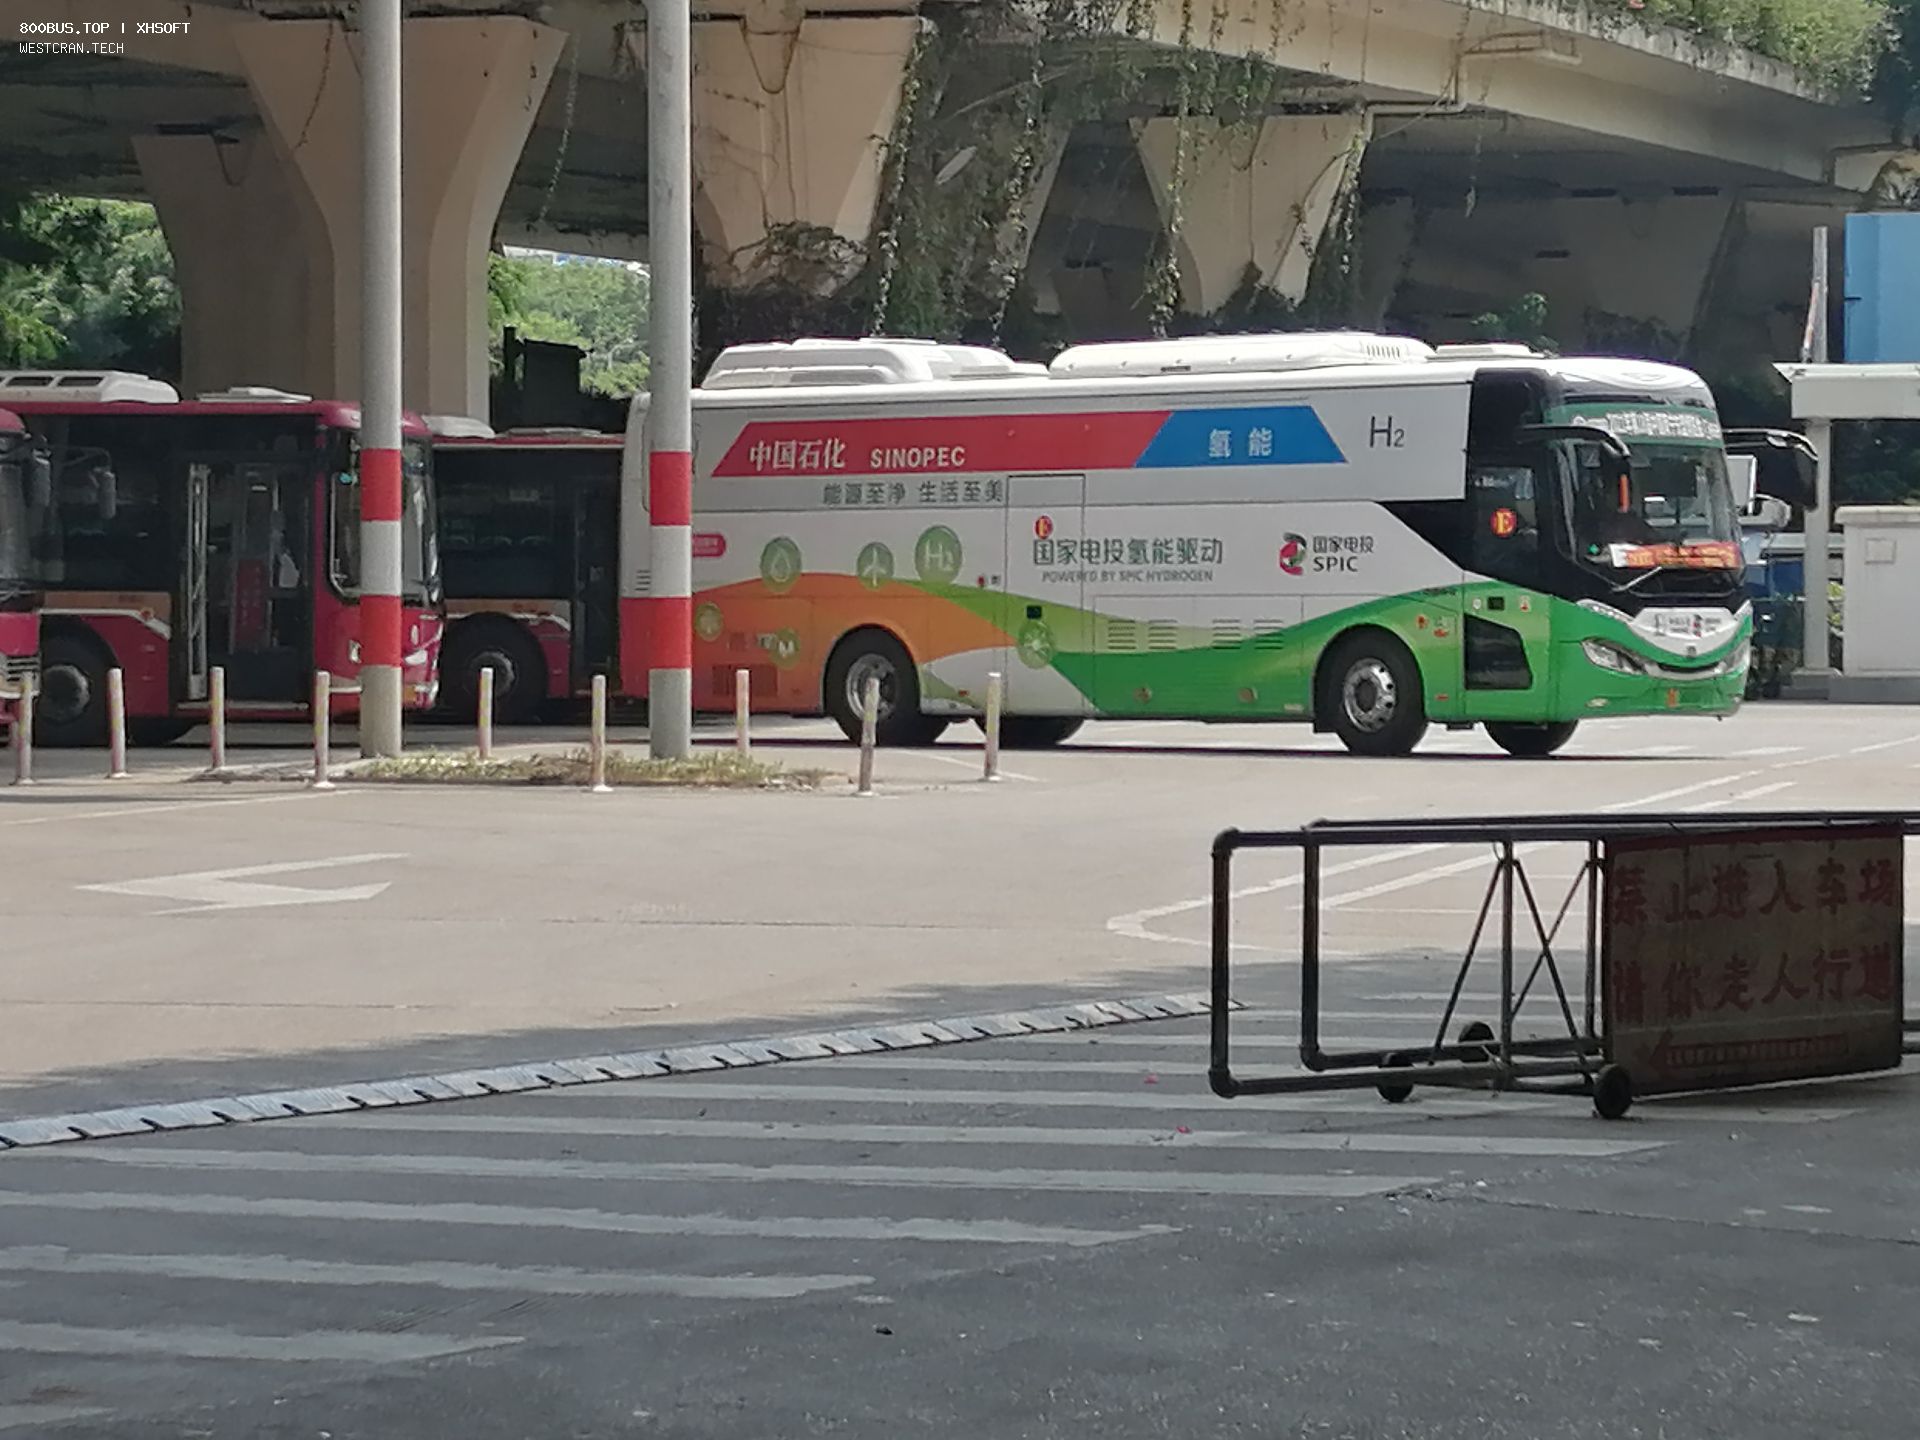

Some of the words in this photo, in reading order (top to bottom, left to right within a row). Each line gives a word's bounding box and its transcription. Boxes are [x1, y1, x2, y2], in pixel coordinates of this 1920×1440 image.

[750, 437, 846, 471] 中国石化
[870, 447, 966, 469] SINOPEC
[823, 481, 905, 504] 能源至净
[919, 479, 1003, 503] 生活至美
[1033, 537, 1223, 565] 国家电投氢能驱动
[1312, 535, 1374, 554] 国家电投
[1313, 556, 1359, 573] SPIC
[1041, 570, 1097, 584] POWERED
[1102, 570, 1115, 583] BY
[1118, 570, 1143, 583] SPIC
[1145, 569, 1214, 583] HYDROGEN
